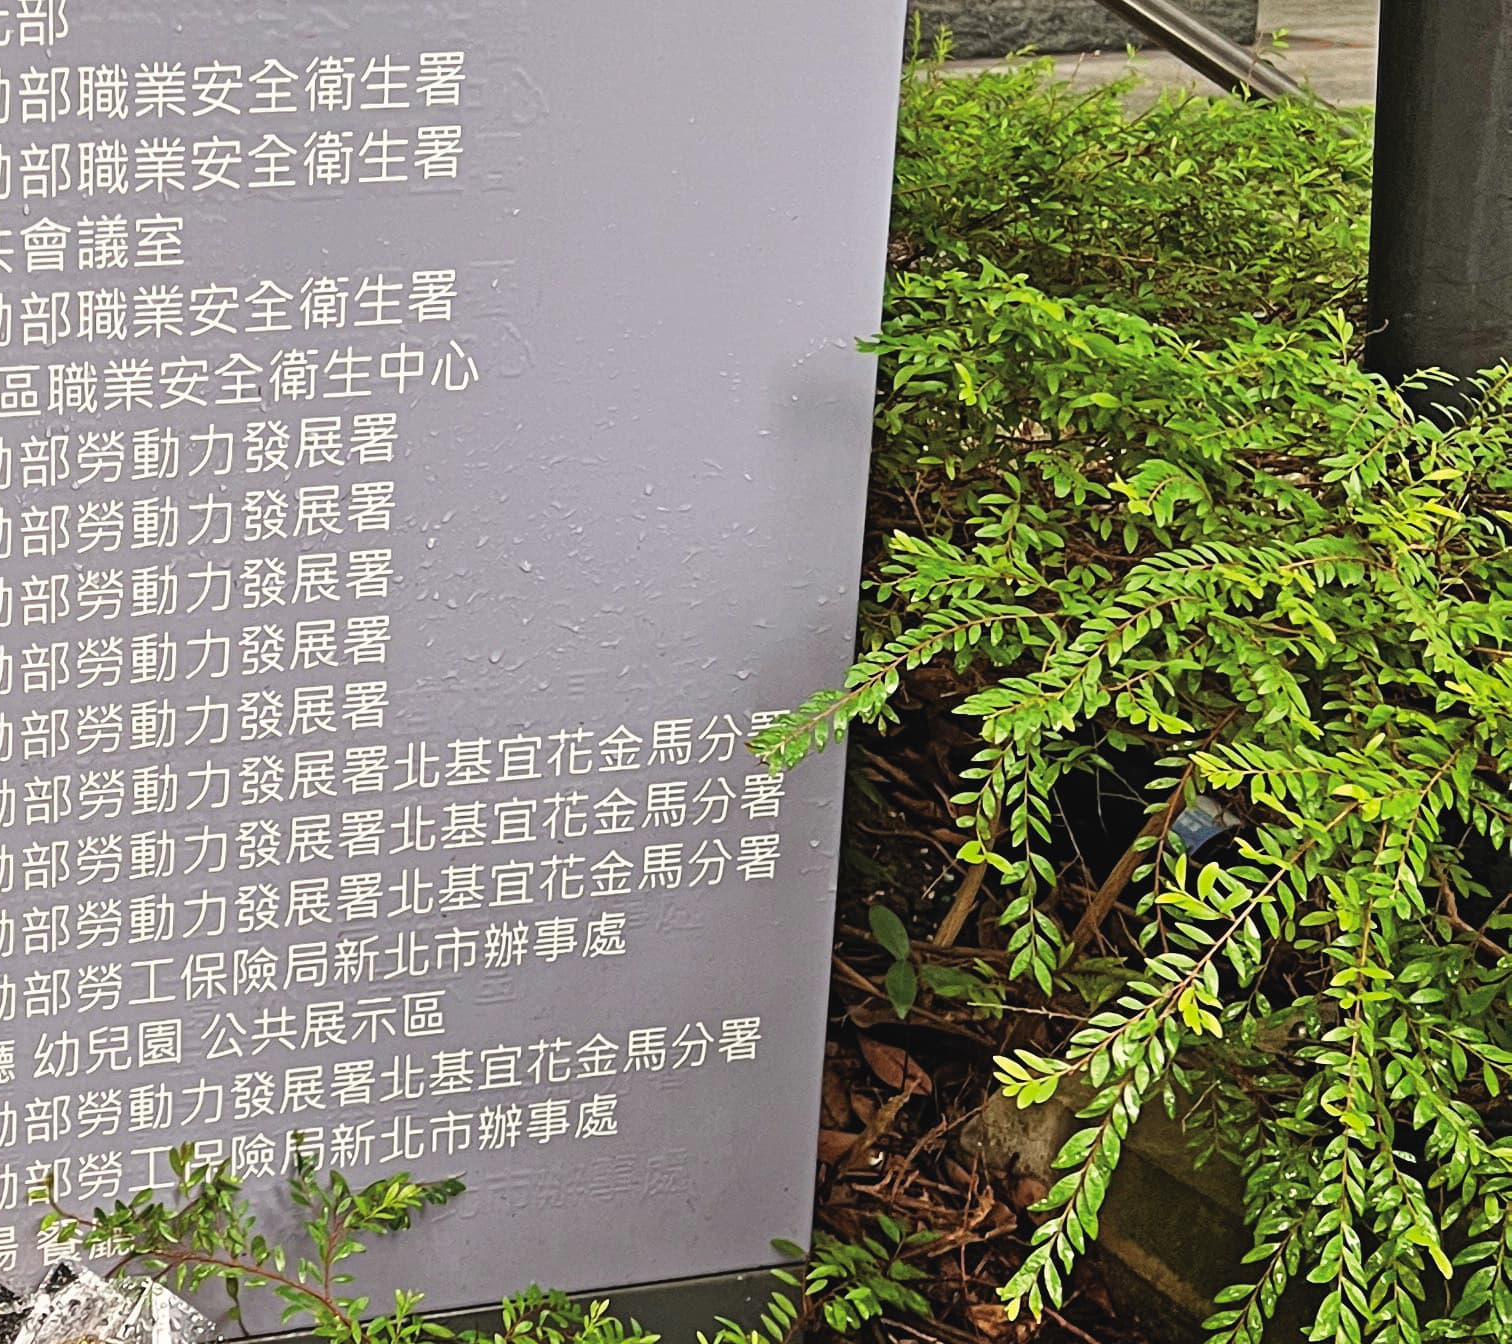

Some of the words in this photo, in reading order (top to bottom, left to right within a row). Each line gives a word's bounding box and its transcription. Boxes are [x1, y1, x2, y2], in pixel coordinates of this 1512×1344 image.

[34, 1019, 181, 1078] 幼兒園
[201, 991, 445, 1059] 公共展示區
